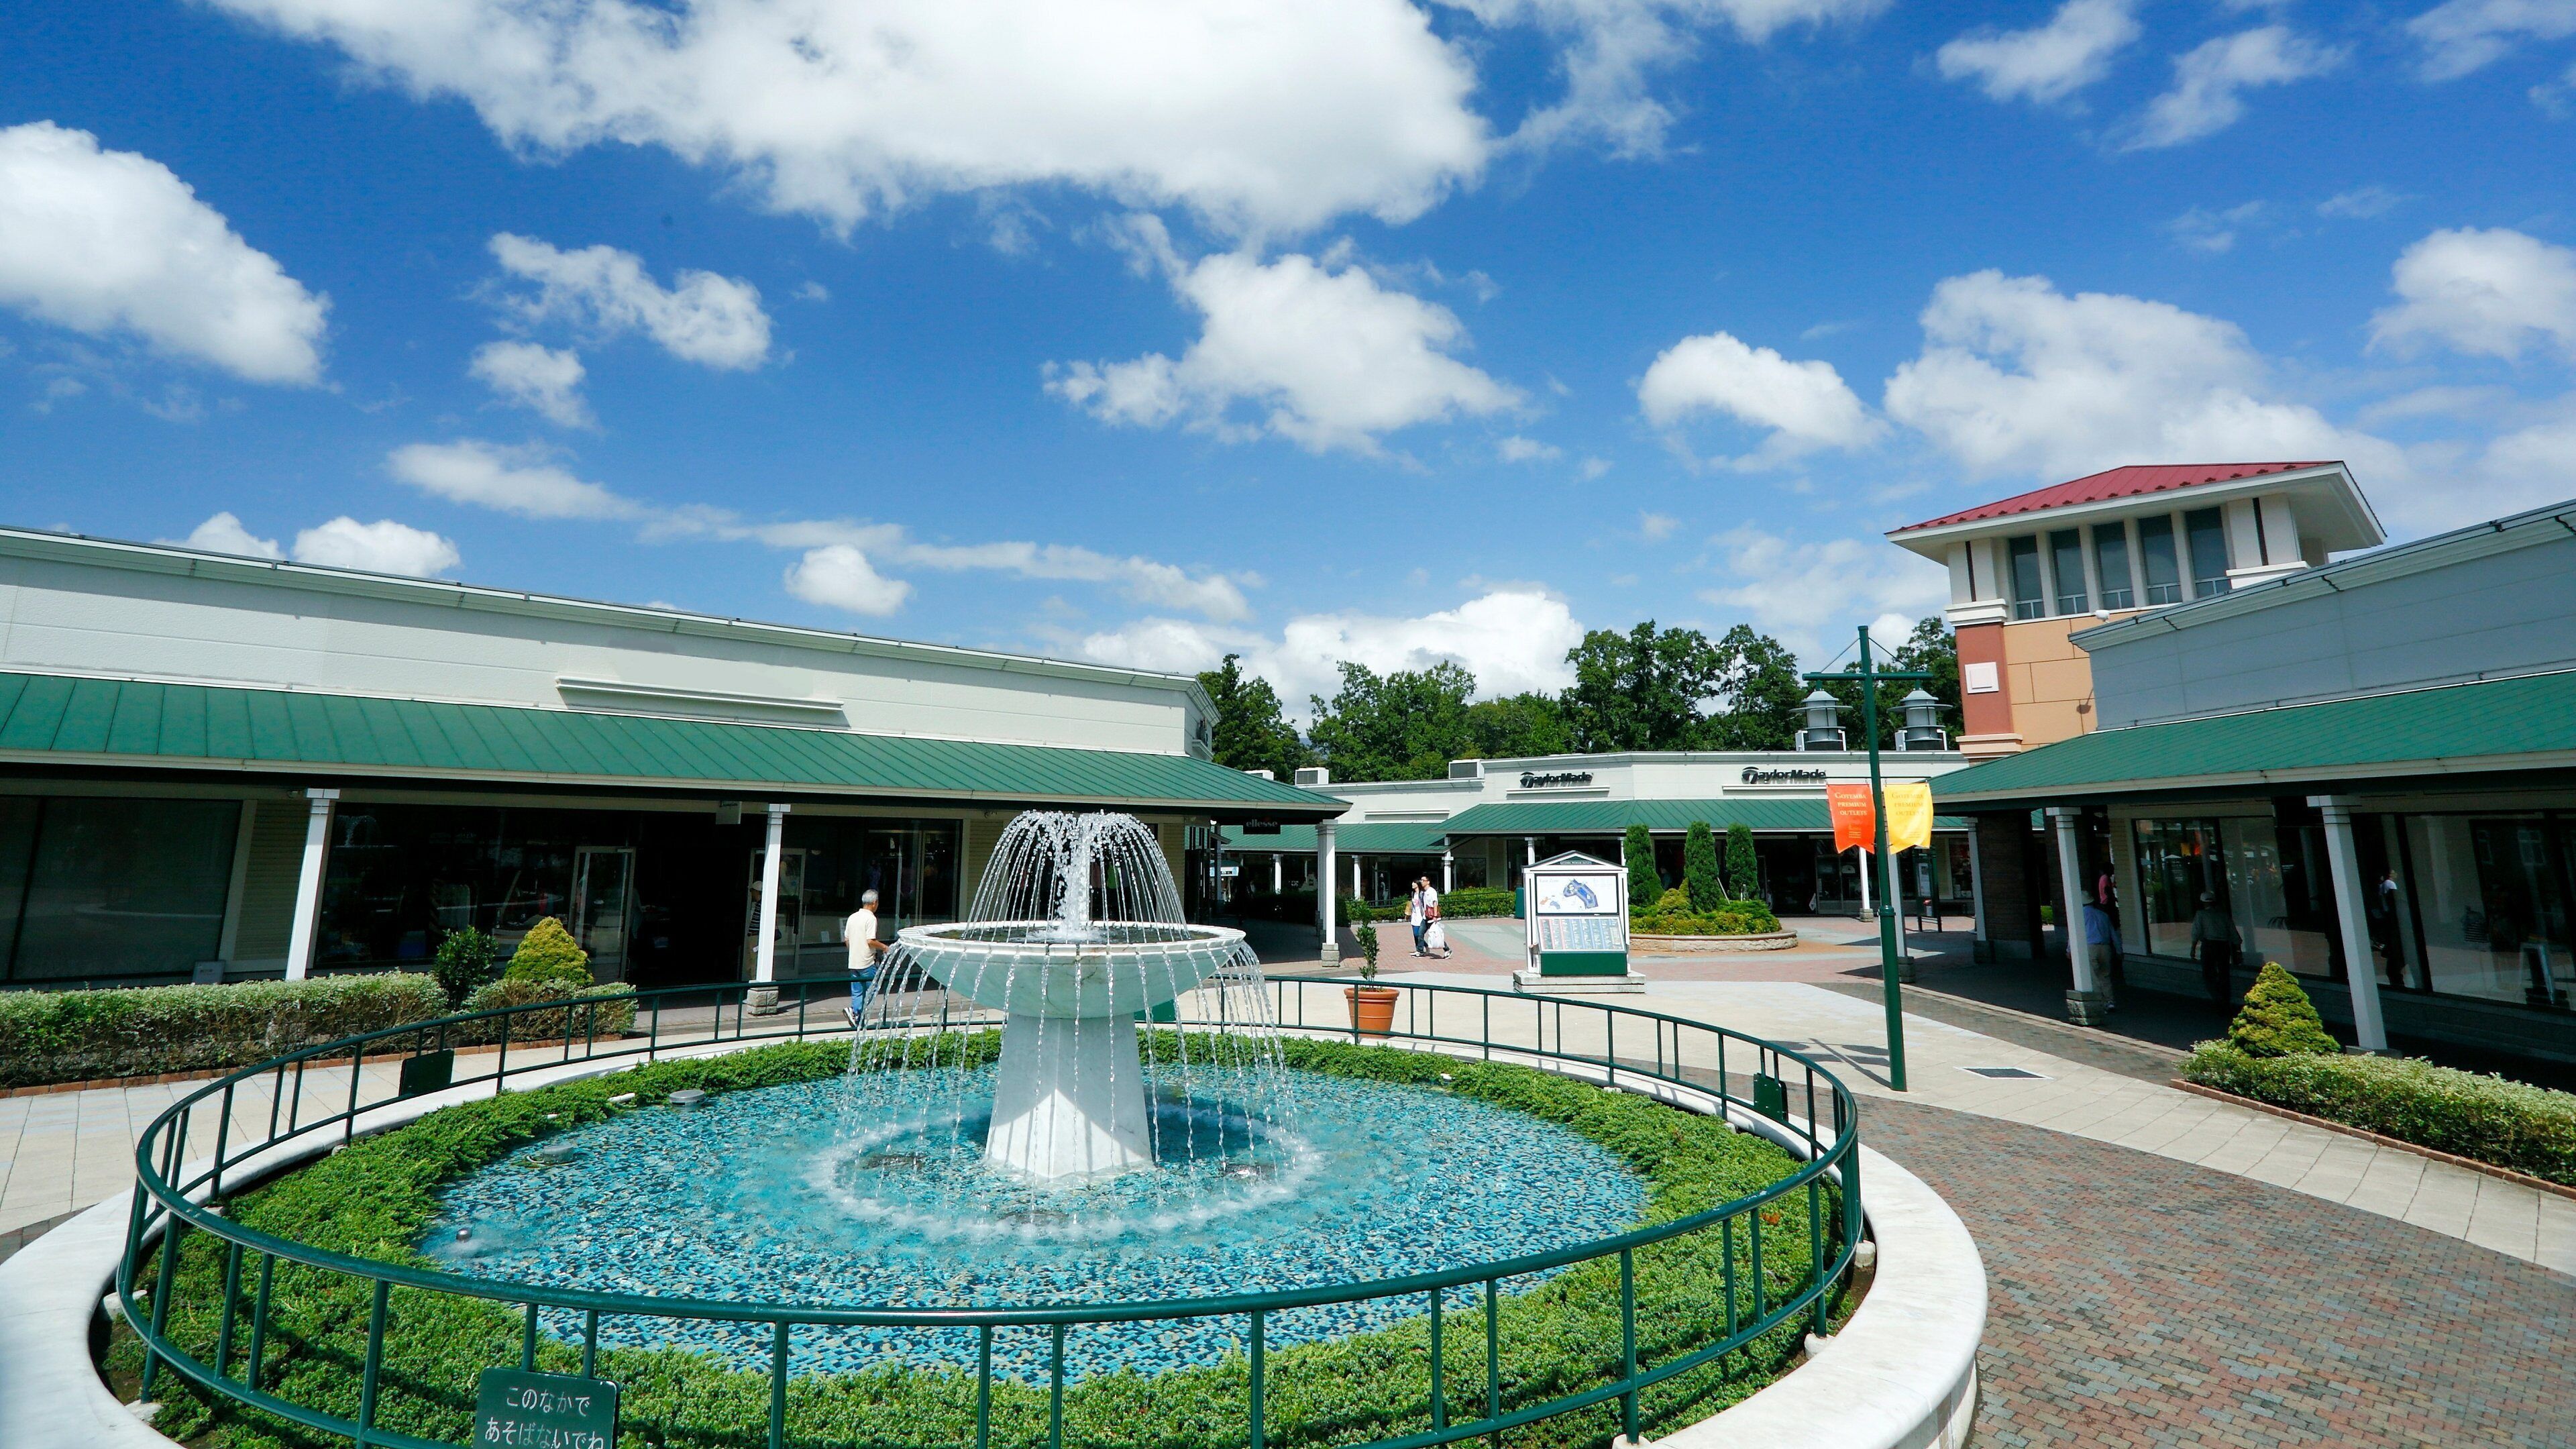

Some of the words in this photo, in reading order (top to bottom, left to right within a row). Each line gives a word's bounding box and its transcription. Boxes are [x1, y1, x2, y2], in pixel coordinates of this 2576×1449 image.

[1519, 771, 1593, 788] TaylorMade
[1741, 766, 1826, 784] TaylorMade
[1246, 818, 1278, 827] ellesse
[506, 1386, 591, 1417] このなかで
[484, 1417, 604, 1449] あそばないでね
